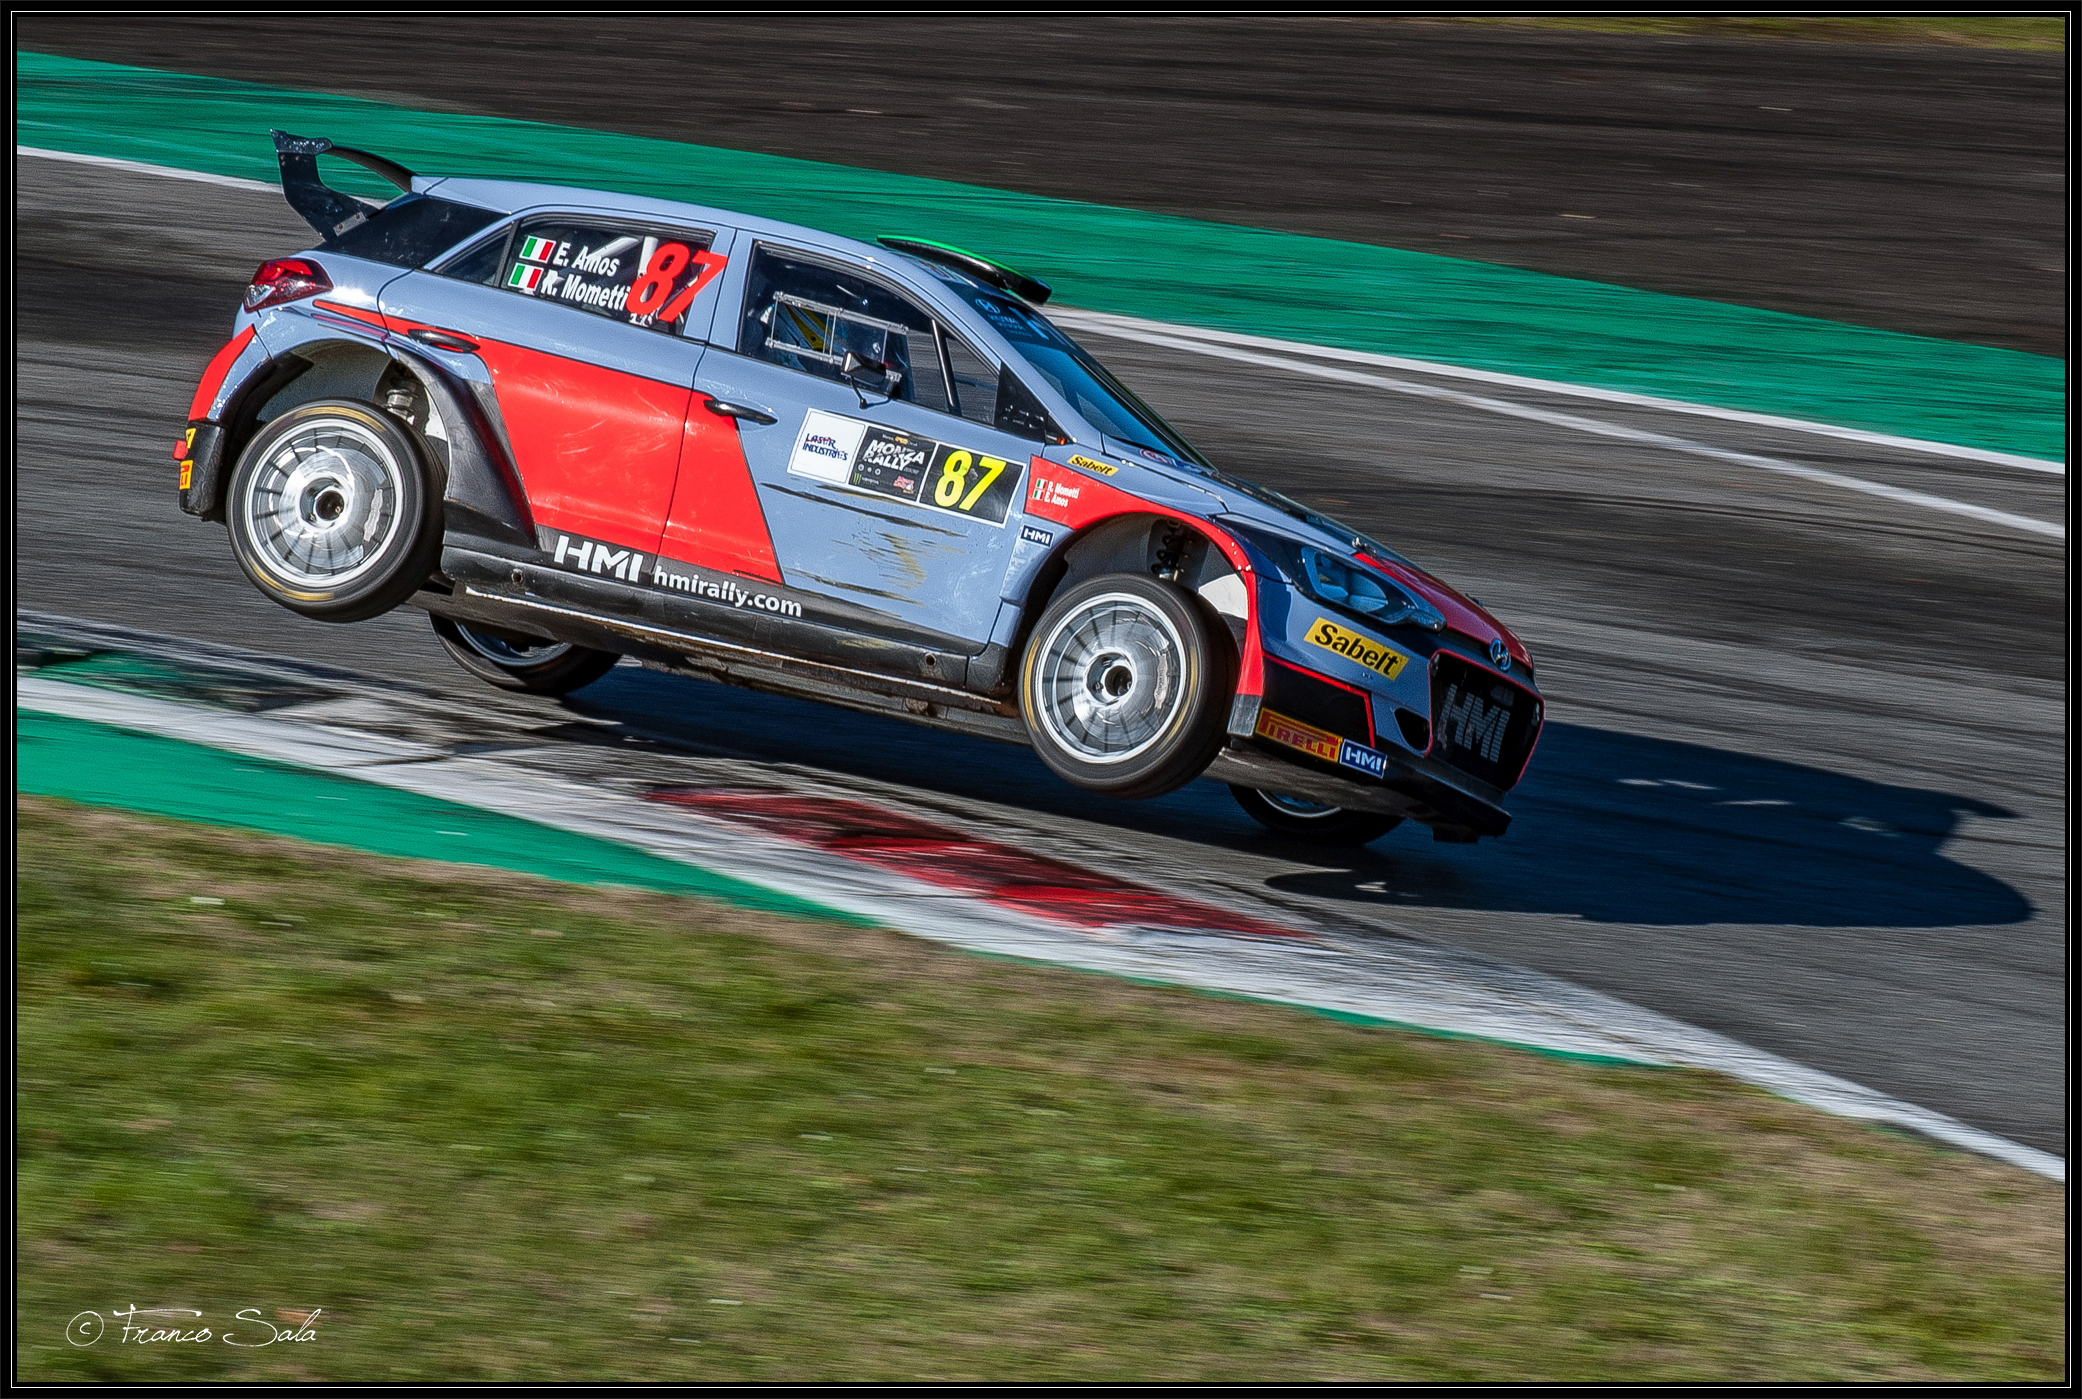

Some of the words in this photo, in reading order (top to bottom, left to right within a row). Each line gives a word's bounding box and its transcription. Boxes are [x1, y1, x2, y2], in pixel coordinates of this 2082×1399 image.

[552, 241, 570, 267] E.
[571, 246, 620, 277] Amos
[540, 269, 557, 297] R.
[560, 273, 632, 312] Mometti
[625, 242, 729, 323] 87
[862, 450, 911, 471] RALLY
[867, 439, 926, 465] MONZA
[1071, 455, 1113, 475] Sabelt
[934, 450, 1007, 511] 87
[553, 534, 644, 582] HMI
[1023, 528, 1051, 545] HMI
[652, 565, 802, 618] hmirally.com
[1314, 623, 1400, 676] Sabelt
[1257, 709, 1338, 760] PIRELLI
[1438, 683, 1511, 763] HMI
[1345, 746, 1382, 772] HMI
